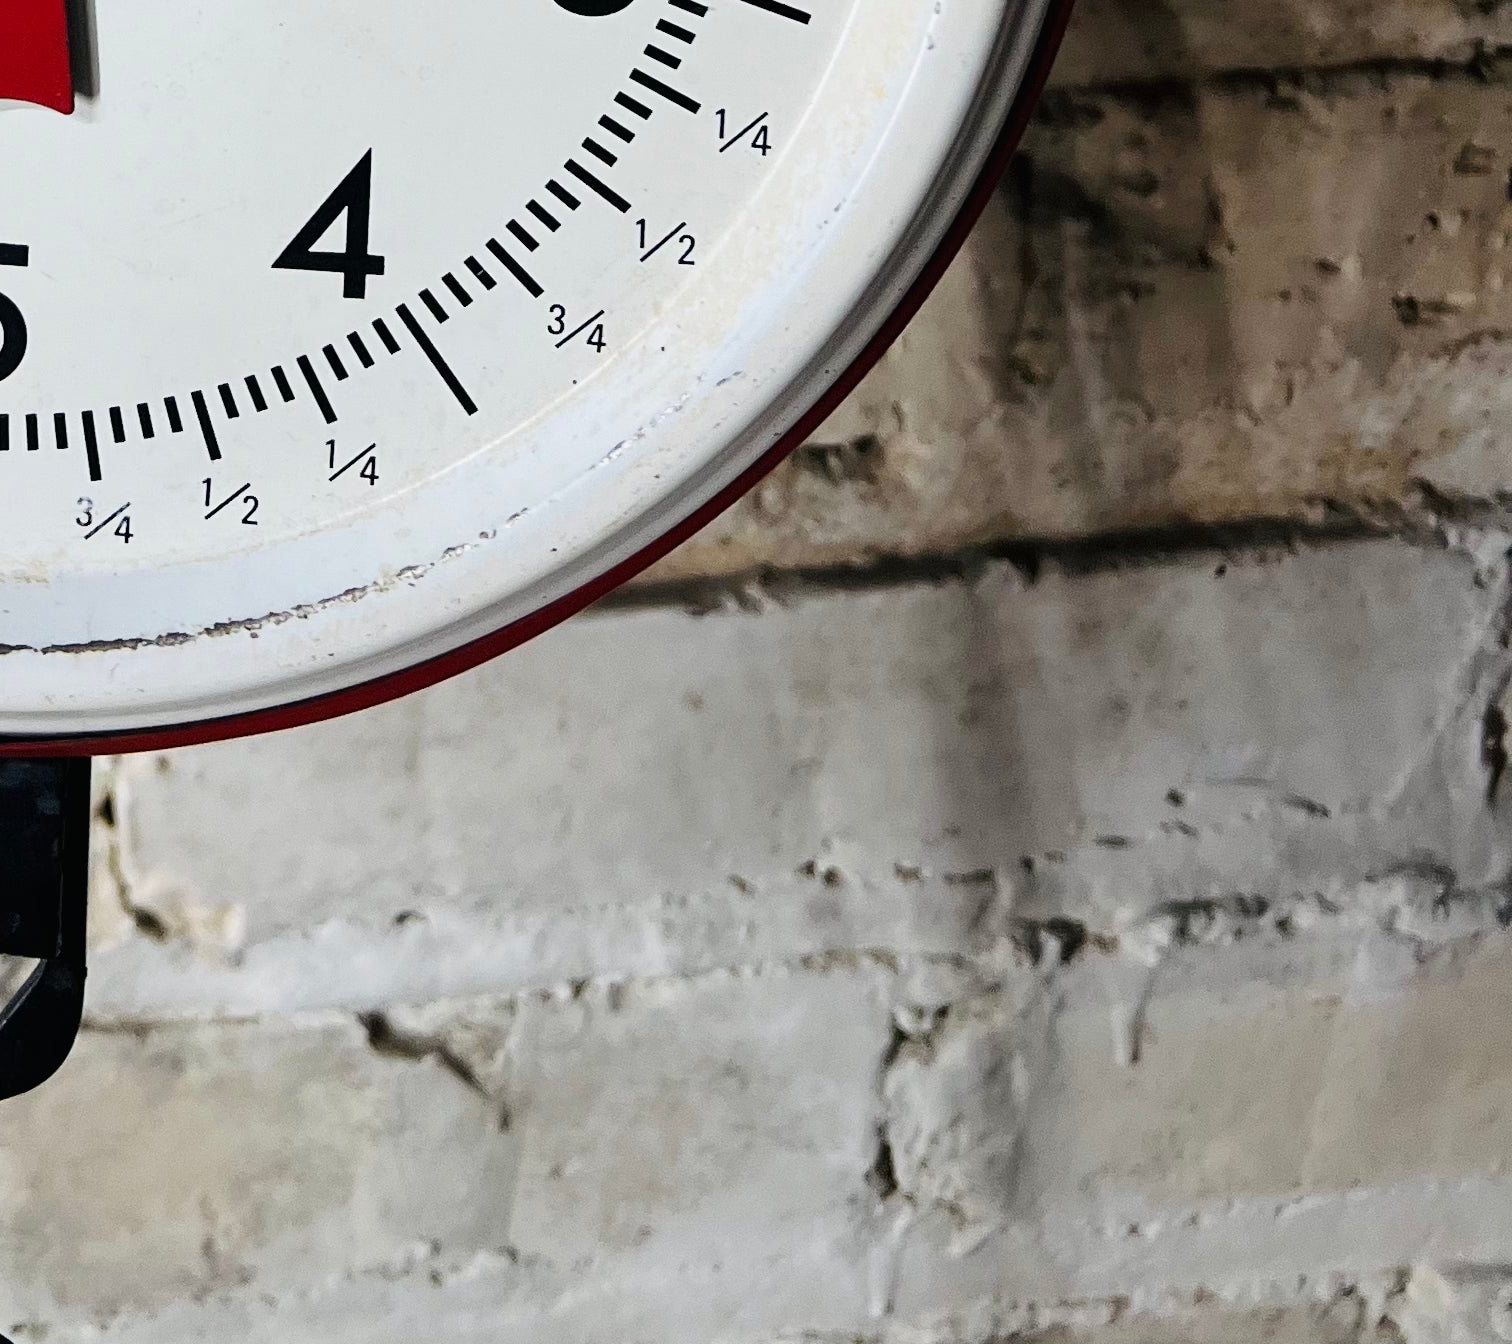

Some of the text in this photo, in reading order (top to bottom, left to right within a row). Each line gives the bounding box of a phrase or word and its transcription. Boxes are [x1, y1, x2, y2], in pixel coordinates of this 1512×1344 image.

[716, 109, 771, 156] 1/4
[271, 147, 385, 299] 4
[636, 218, 695, 265] 1/2
[547, 304, 606, 353] 3/4
[326, 439, 379, 486] 1/4
[76, 498, 133, 543] 3/4
[202, 478, 258, 525] 1/2
